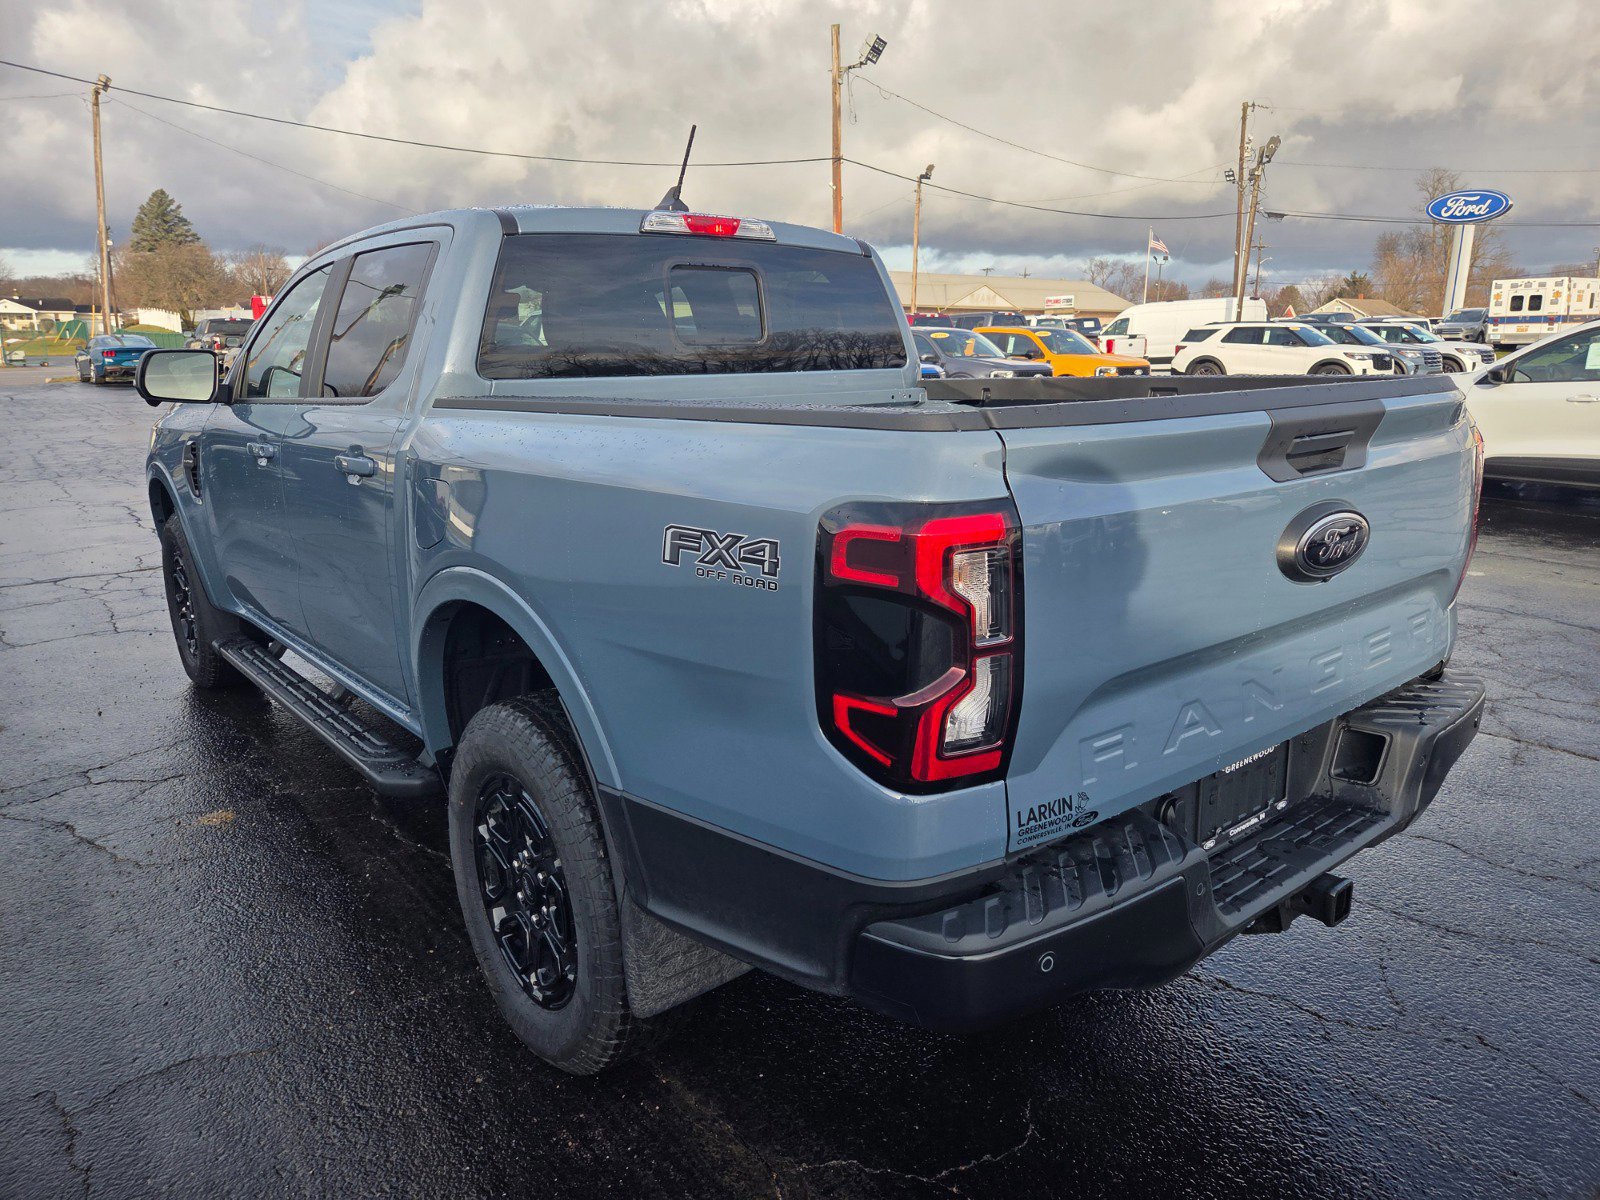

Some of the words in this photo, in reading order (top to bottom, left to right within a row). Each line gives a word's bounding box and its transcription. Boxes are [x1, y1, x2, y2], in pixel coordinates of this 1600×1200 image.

[1441, 195, 1492, 217] Ford
[662, 523, 781, 579] FX4
[1319, 526, 1358, 563] Ford
[695, 567, 726, 580] OFF
[732, 573, 779, 592] ROAD
[1079, 607, 1436, 786] RANGER
[1017, 795, 1073, 828] LARKIN
[1018, 813, 1073, 837] GREENEWOOD
